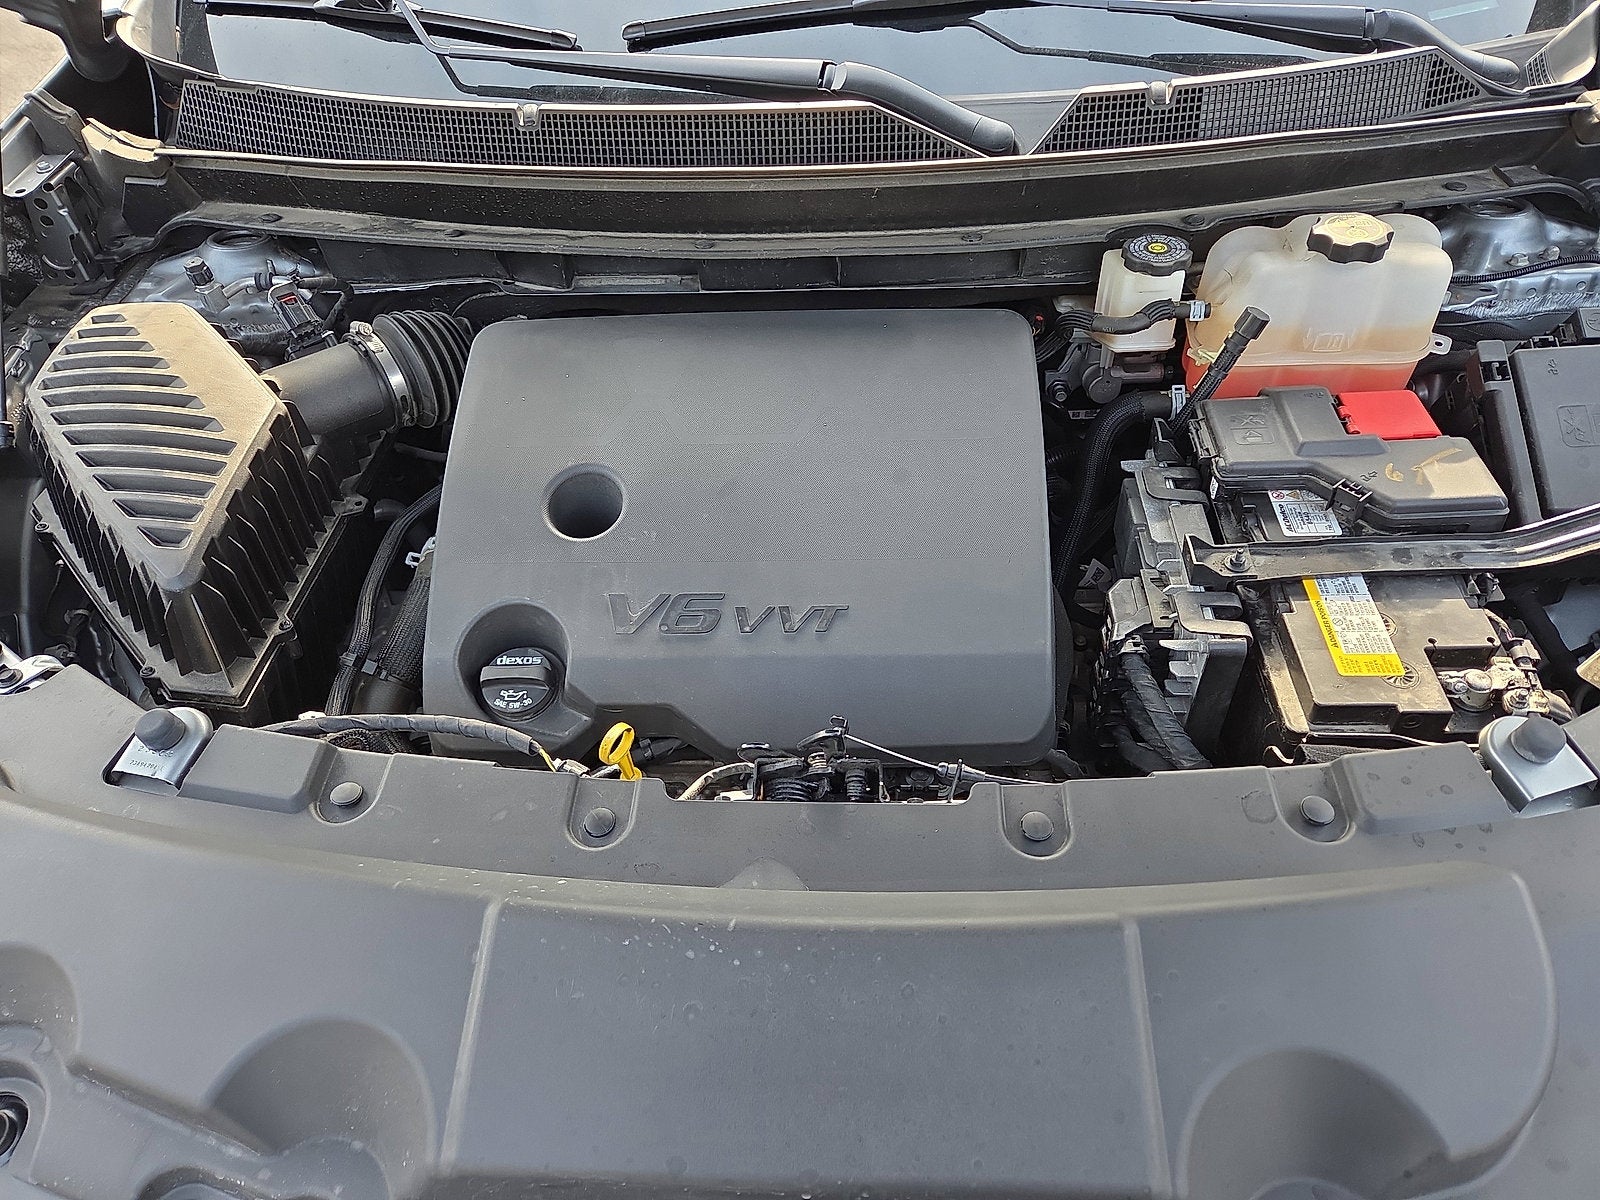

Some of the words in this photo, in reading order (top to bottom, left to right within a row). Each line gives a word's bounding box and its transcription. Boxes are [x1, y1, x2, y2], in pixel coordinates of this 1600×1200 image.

[606, 592, 726, 635] V6
[734, 603, 850, 635] VVT
[496, 655, 544, 665] dexos
[493, 698, 508, 708] SAE
[508, 697, 533, 709] 5W-30
